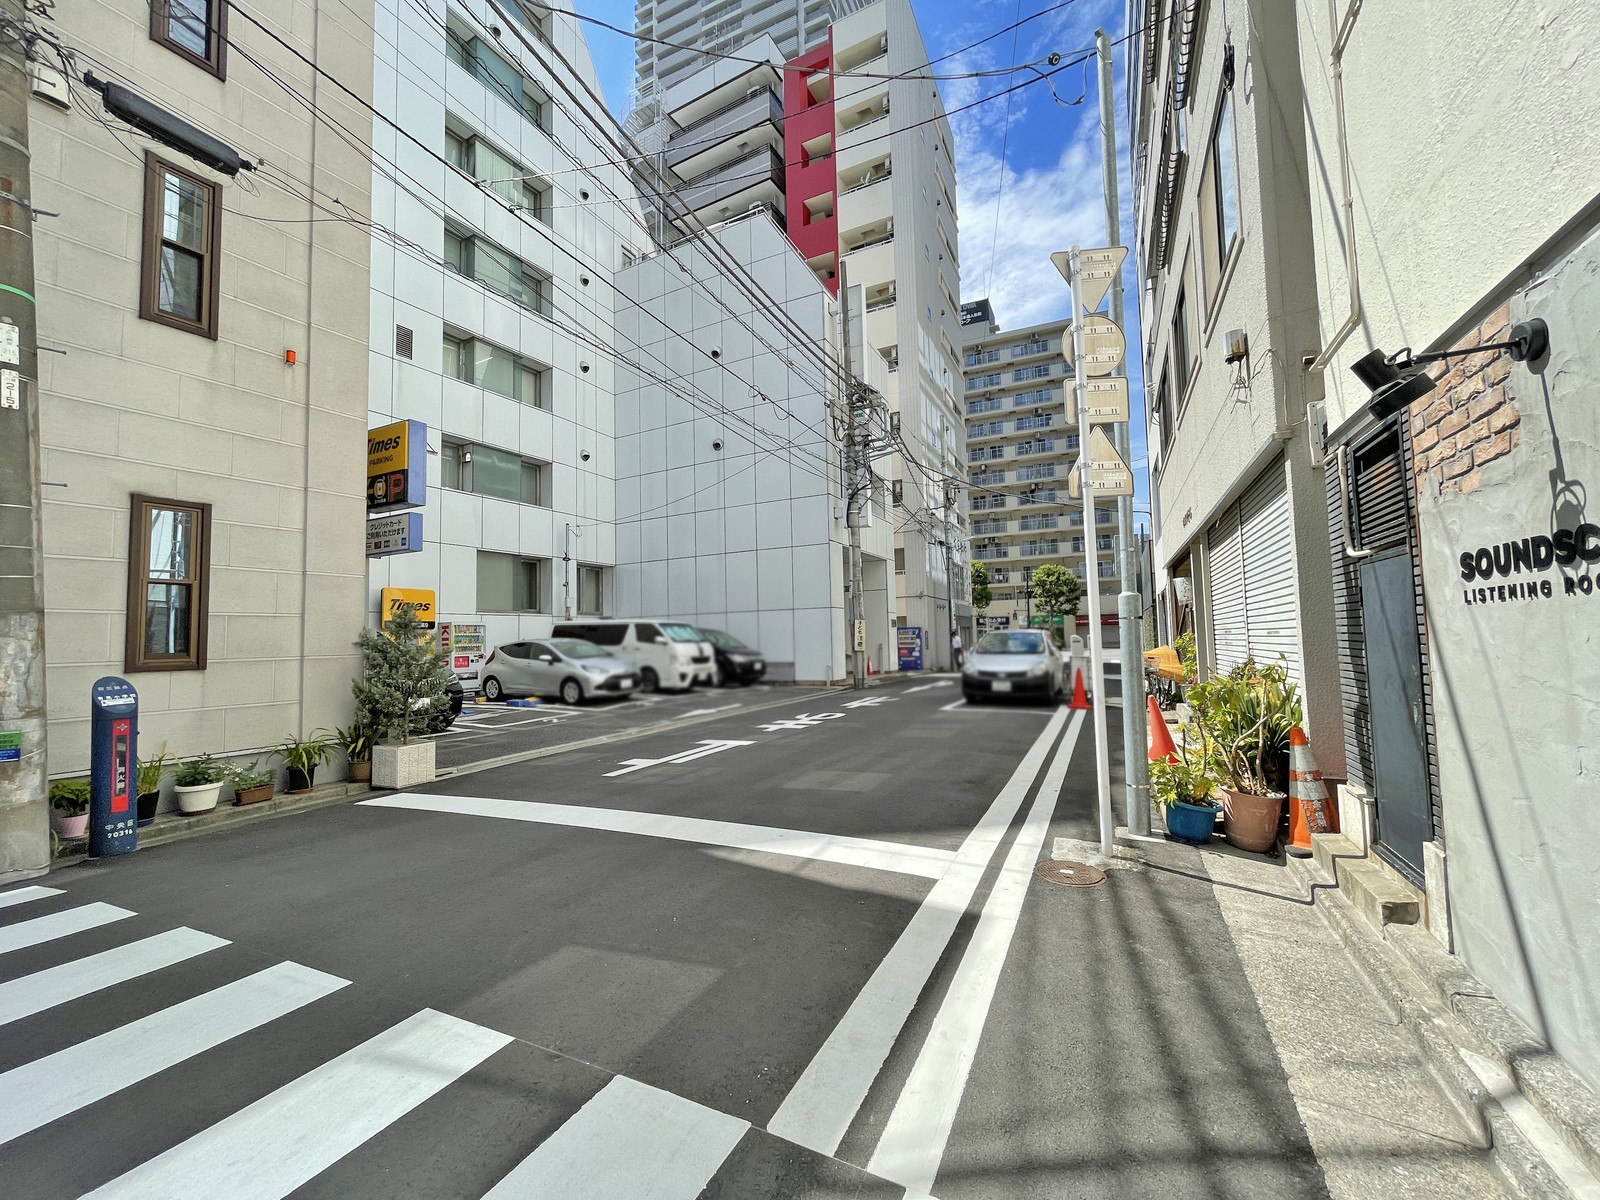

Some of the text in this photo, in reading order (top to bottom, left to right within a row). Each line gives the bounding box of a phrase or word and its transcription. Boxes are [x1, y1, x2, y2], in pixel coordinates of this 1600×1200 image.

[369, 454, 394, 466] PARKING
[370, 519, 402, 531] クレジットカード
[367, 527, 405, 540] ご利用いただけます
[1460, 523, 1600, 583] SOUNDSC
[1464, 580, 1552, 605] LISTENING
